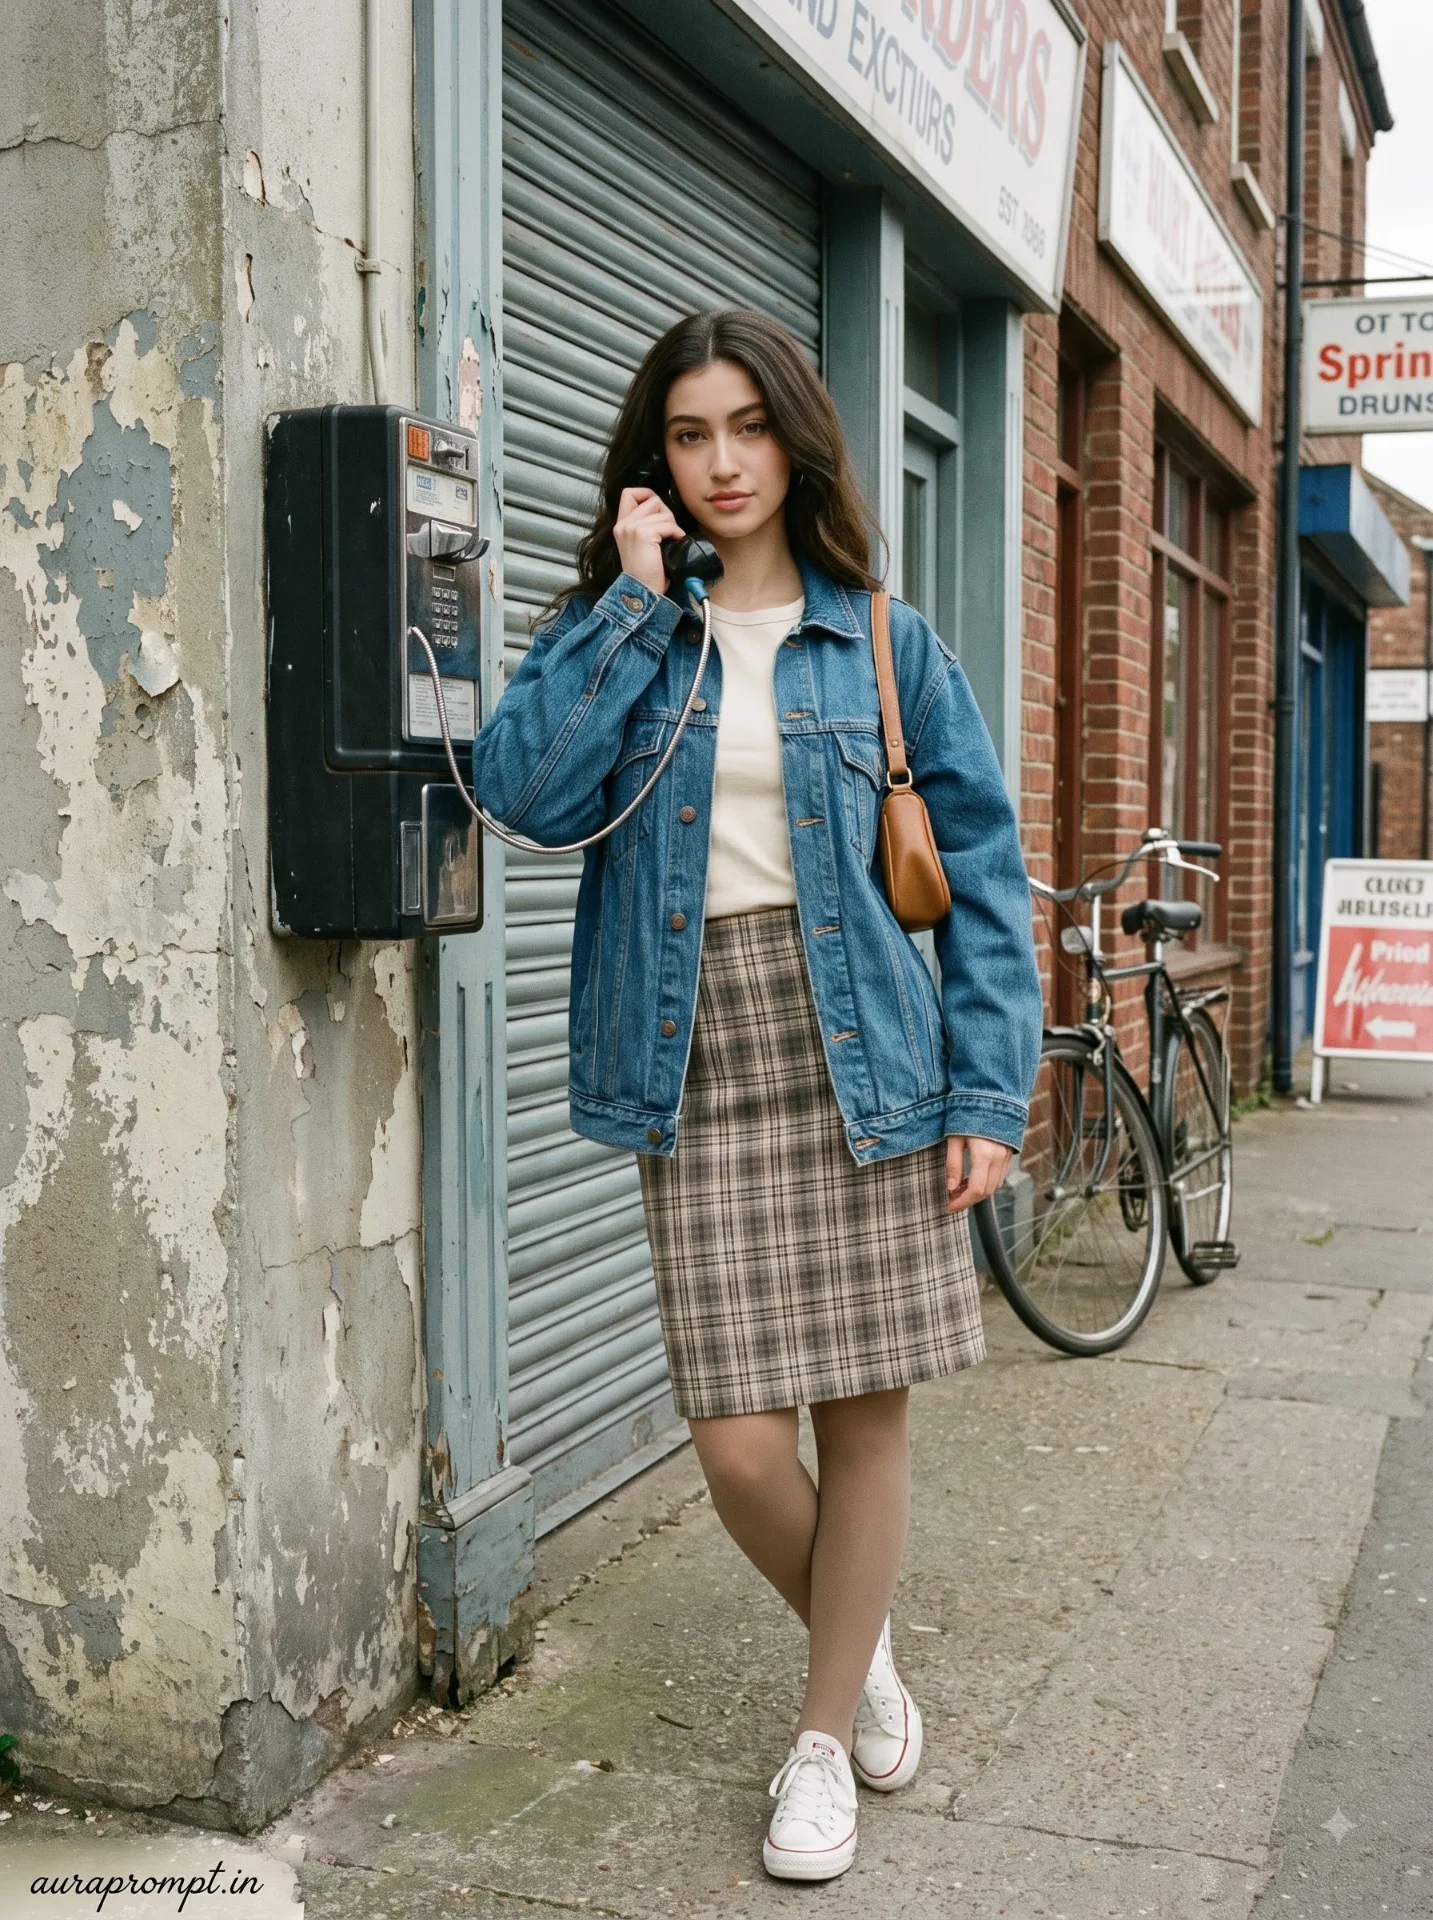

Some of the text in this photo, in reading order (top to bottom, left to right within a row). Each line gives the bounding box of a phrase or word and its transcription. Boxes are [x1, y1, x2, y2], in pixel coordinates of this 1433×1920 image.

[997, 183, 1019, 233] EST
[1355, 313, 1391, 335] OT
[1317, 341, 1432, 390] Sprin
